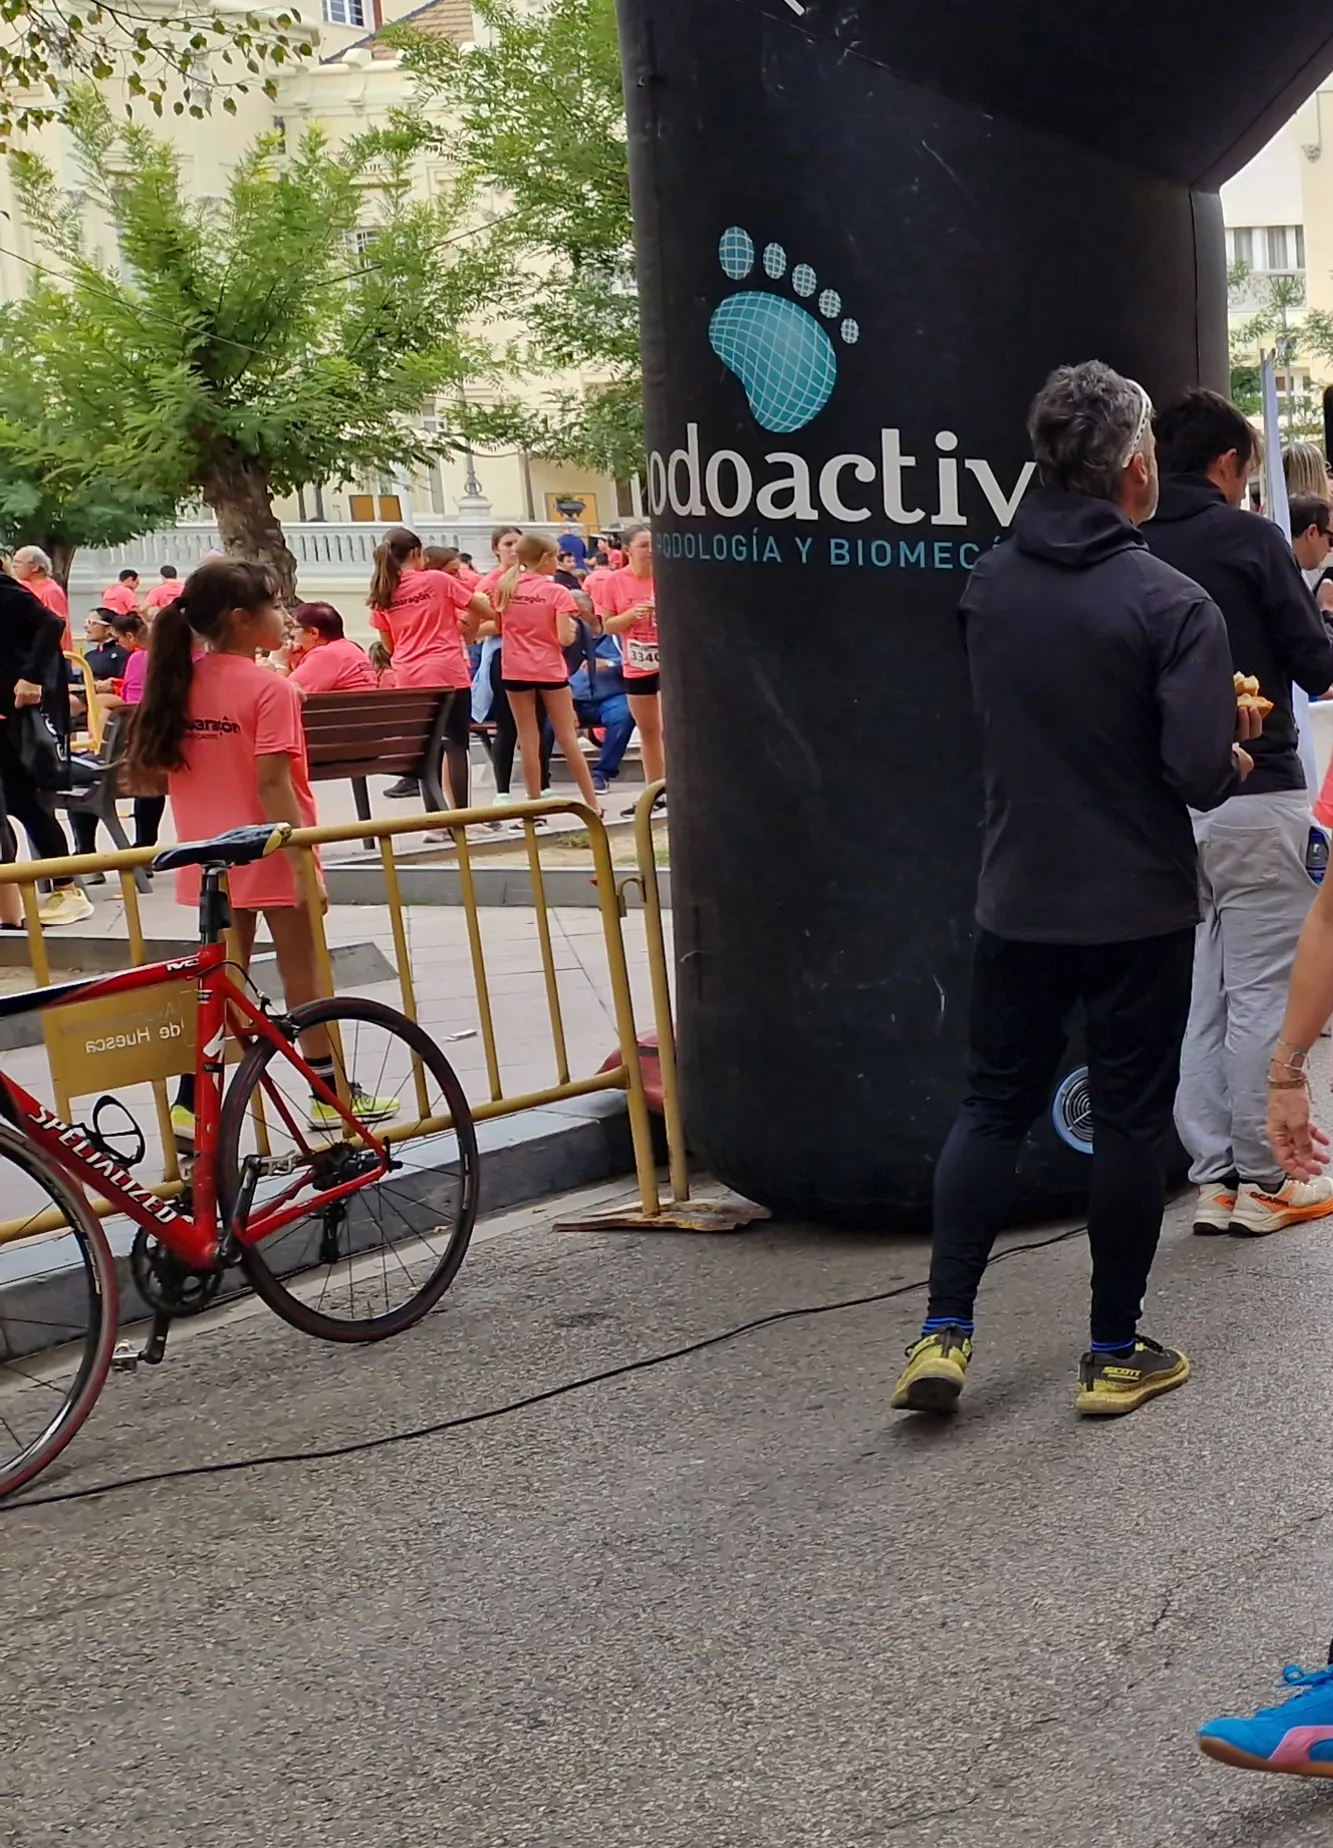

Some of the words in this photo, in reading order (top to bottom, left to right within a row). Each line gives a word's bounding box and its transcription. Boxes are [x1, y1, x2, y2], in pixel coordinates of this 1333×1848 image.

[656, 528, 782, 564] PODOLOGÍA
[794, 537, 813, 565] Y
[830, 536, 1001, 570] BIOMEC
